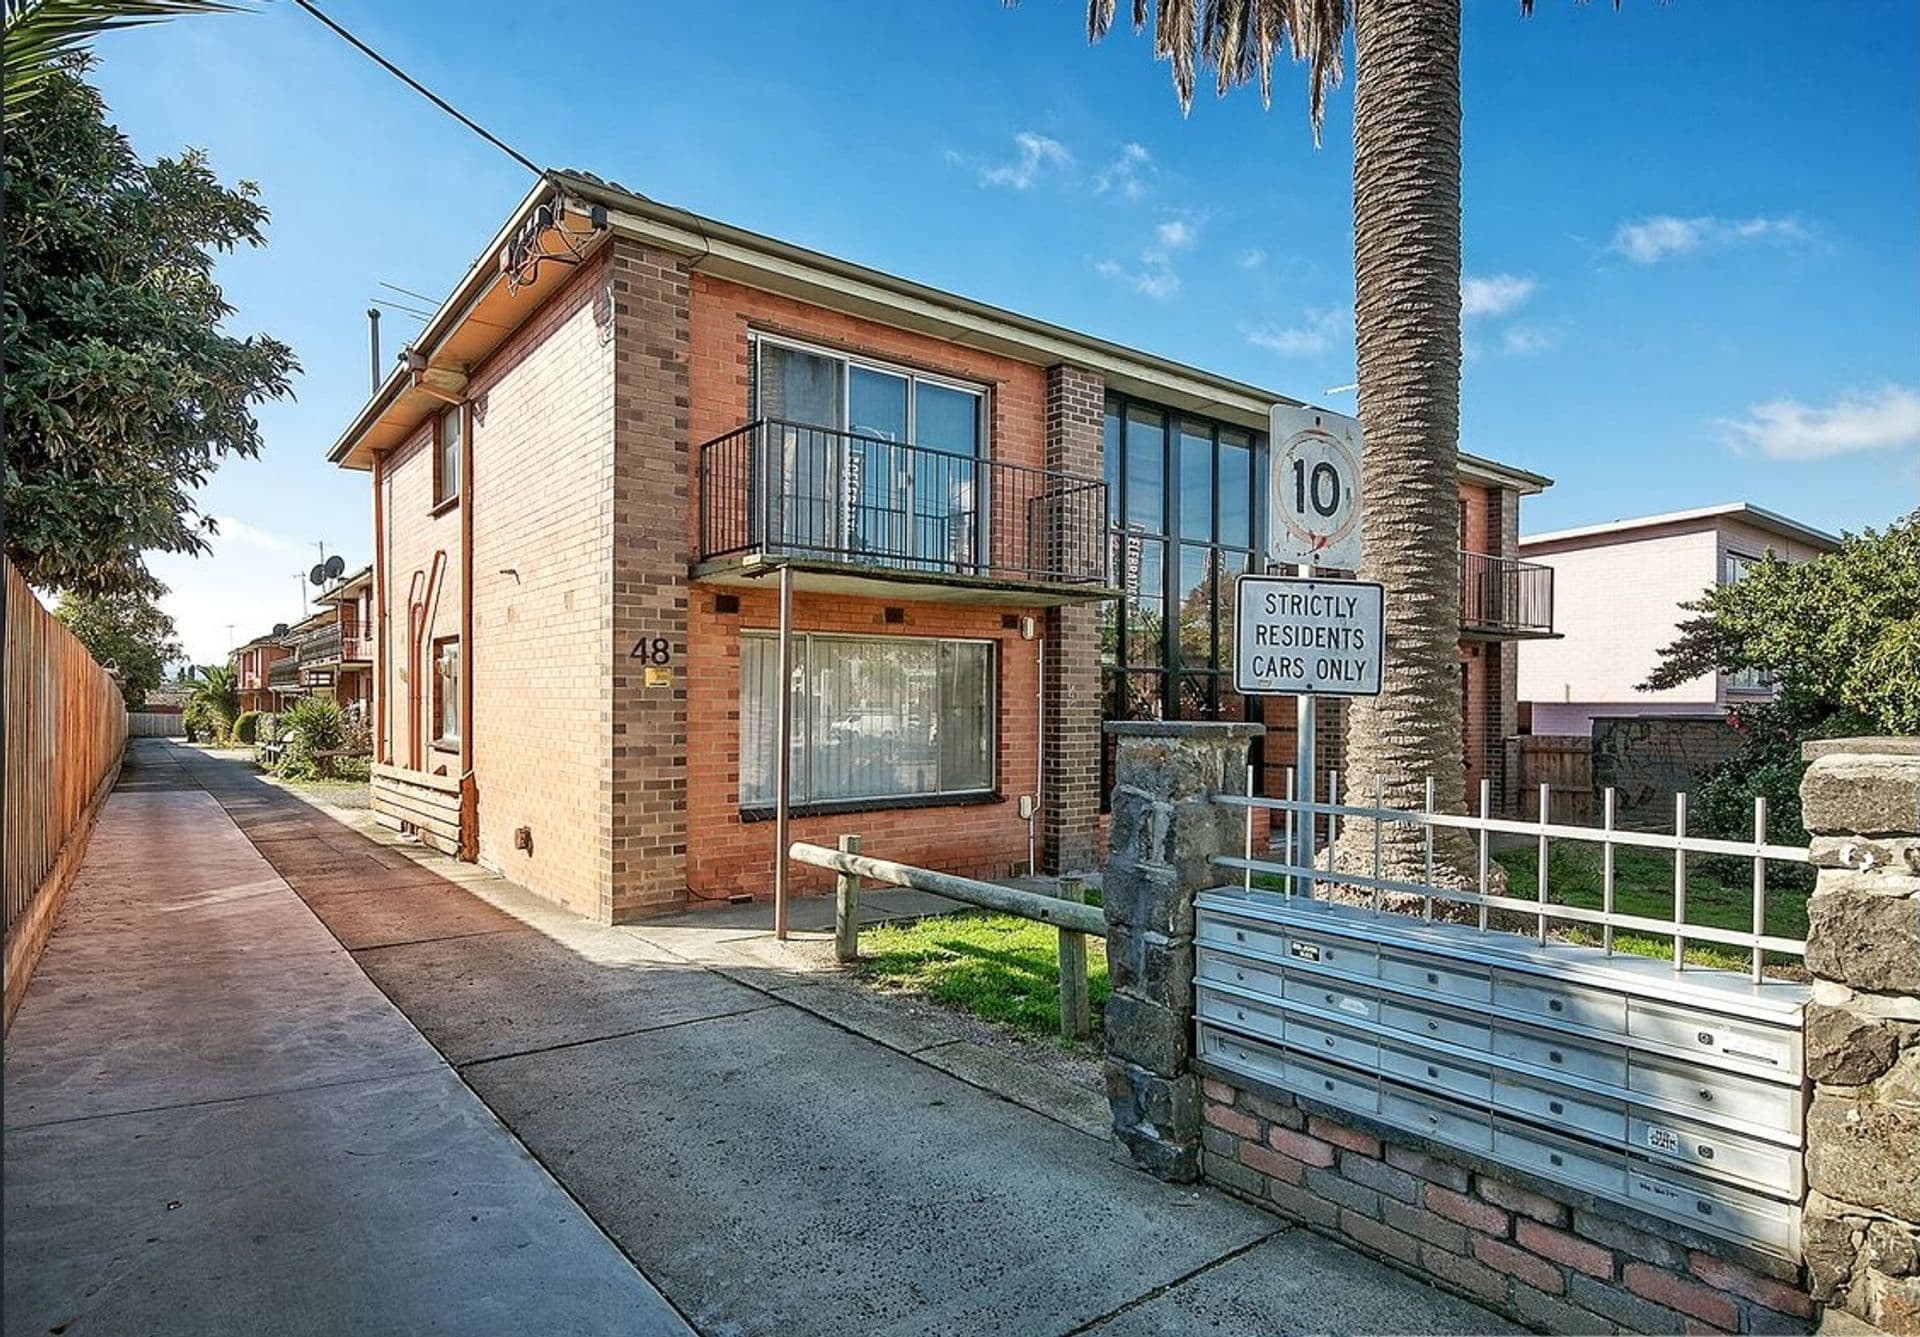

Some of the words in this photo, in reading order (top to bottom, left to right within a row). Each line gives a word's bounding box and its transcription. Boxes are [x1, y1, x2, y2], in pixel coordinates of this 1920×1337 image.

[1293, 459, 1340, 518] 10
[1265, 592, 1358, 619] STRICTLY
[1255, 624, 1365, 650] RESIDENTS
[630, 636, 670, 666] 48
[1252, 655, 1305, 679] CARS
[1316, 658, 1366, 681] ONLY
